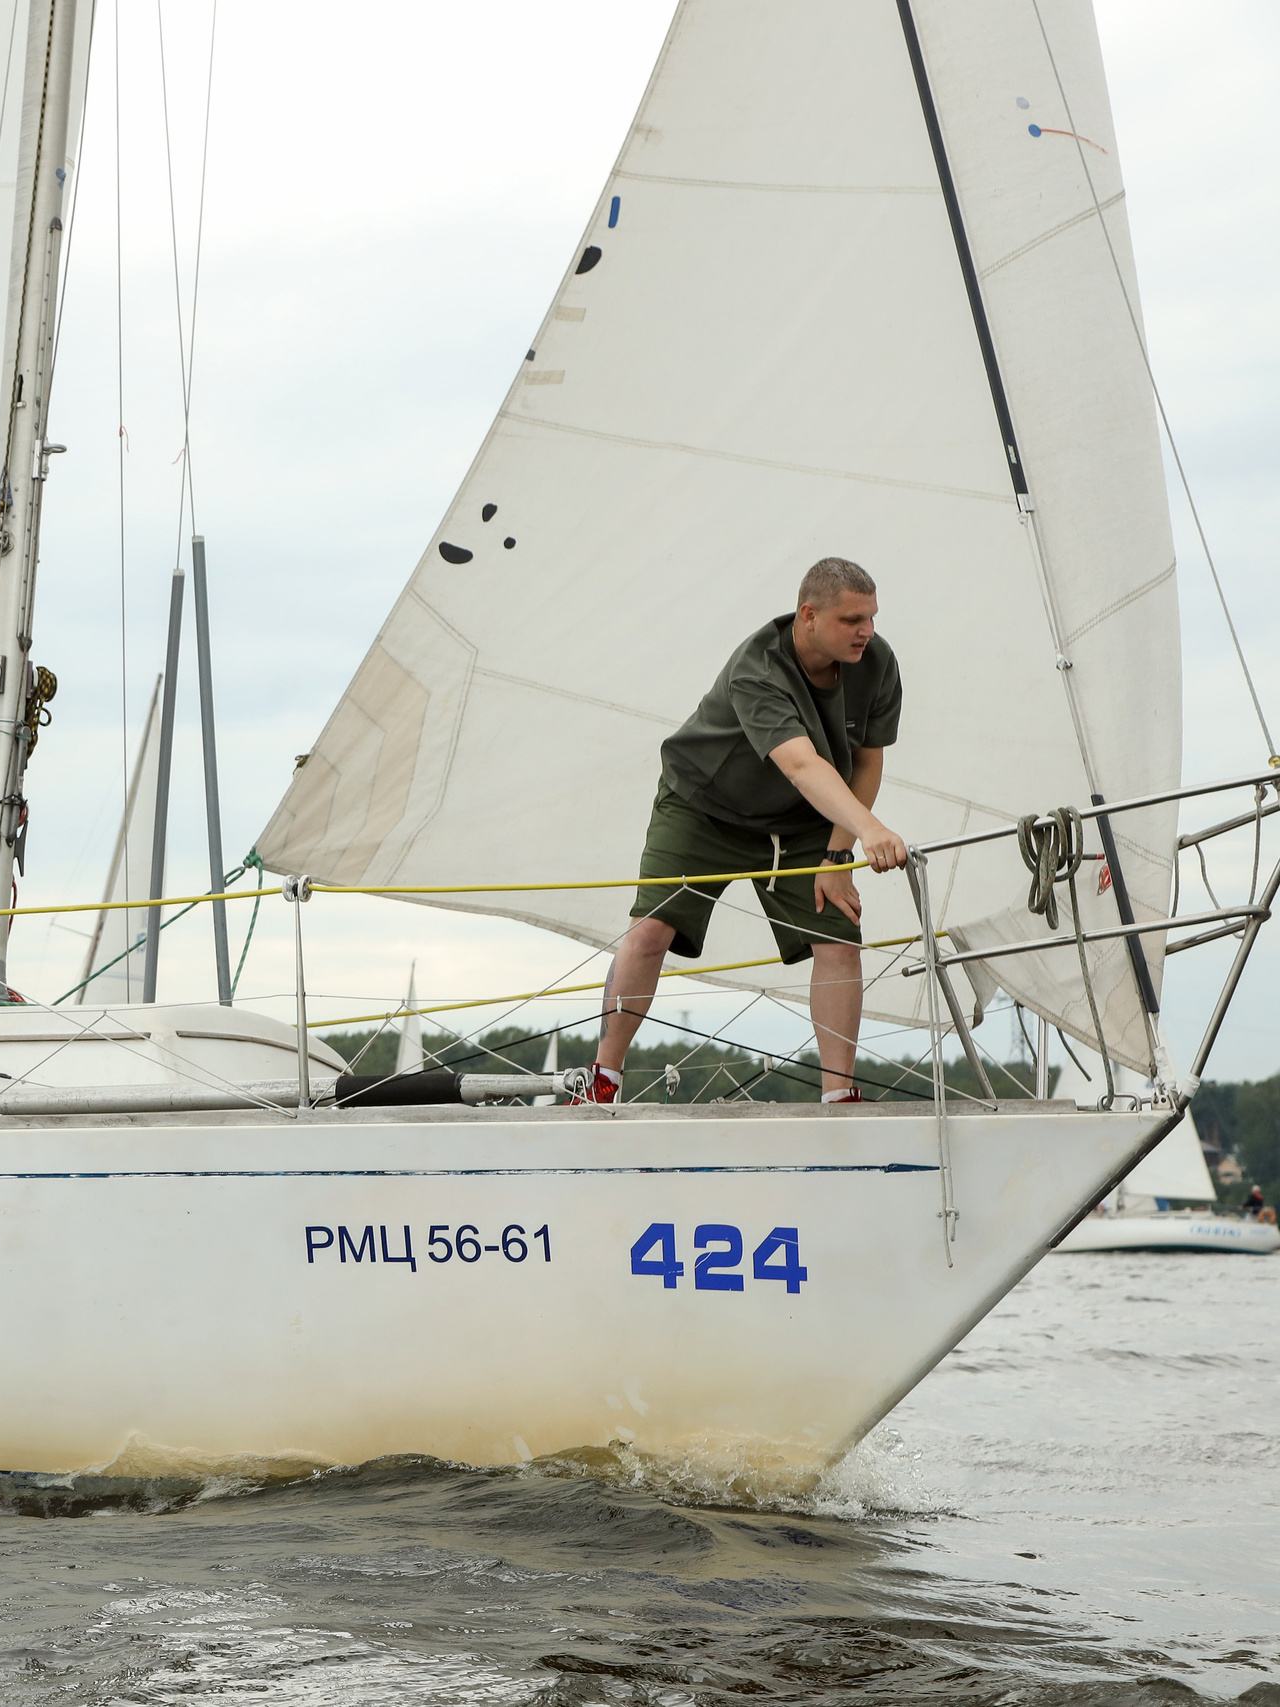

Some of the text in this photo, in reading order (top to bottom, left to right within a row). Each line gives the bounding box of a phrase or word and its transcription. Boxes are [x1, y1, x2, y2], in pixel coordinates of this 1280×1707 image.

[305, 1224, 552, 1273] РМЦ 56-61
[630, 1222, 809, 1294] 424
